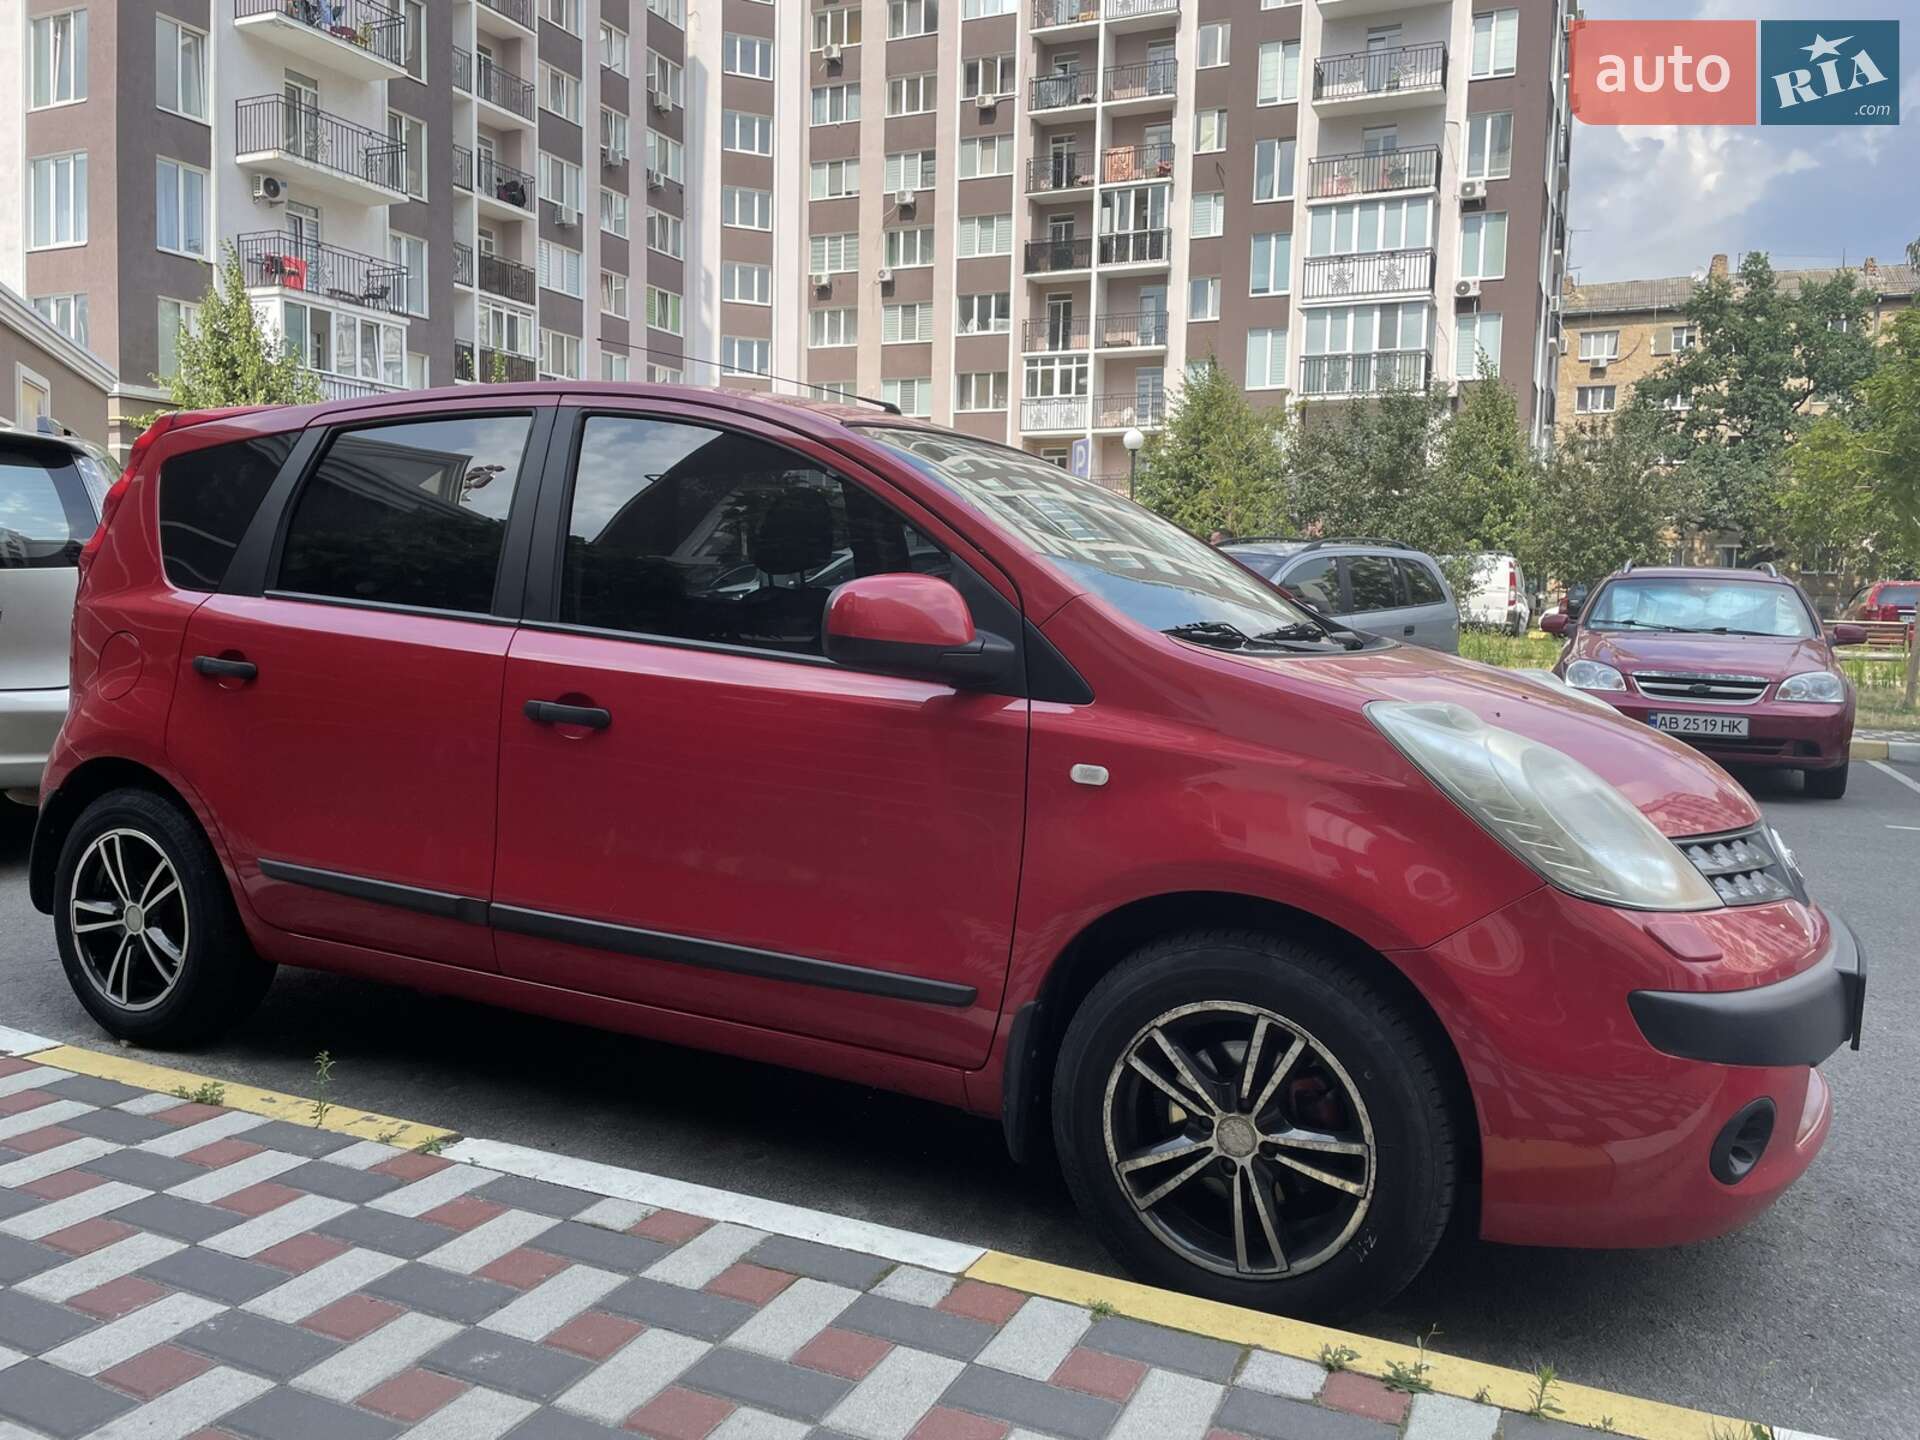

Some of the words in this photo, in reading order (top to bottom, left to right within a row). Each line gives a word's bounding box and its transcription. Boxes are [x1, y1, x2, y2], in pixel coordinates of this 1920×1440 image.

[1076, 444, 1086, 475] P
[1658, 716, 1679, 729] AB
[1682, 717, 1717, 732] 2519
[1720, 719, 1742, 733] HK
